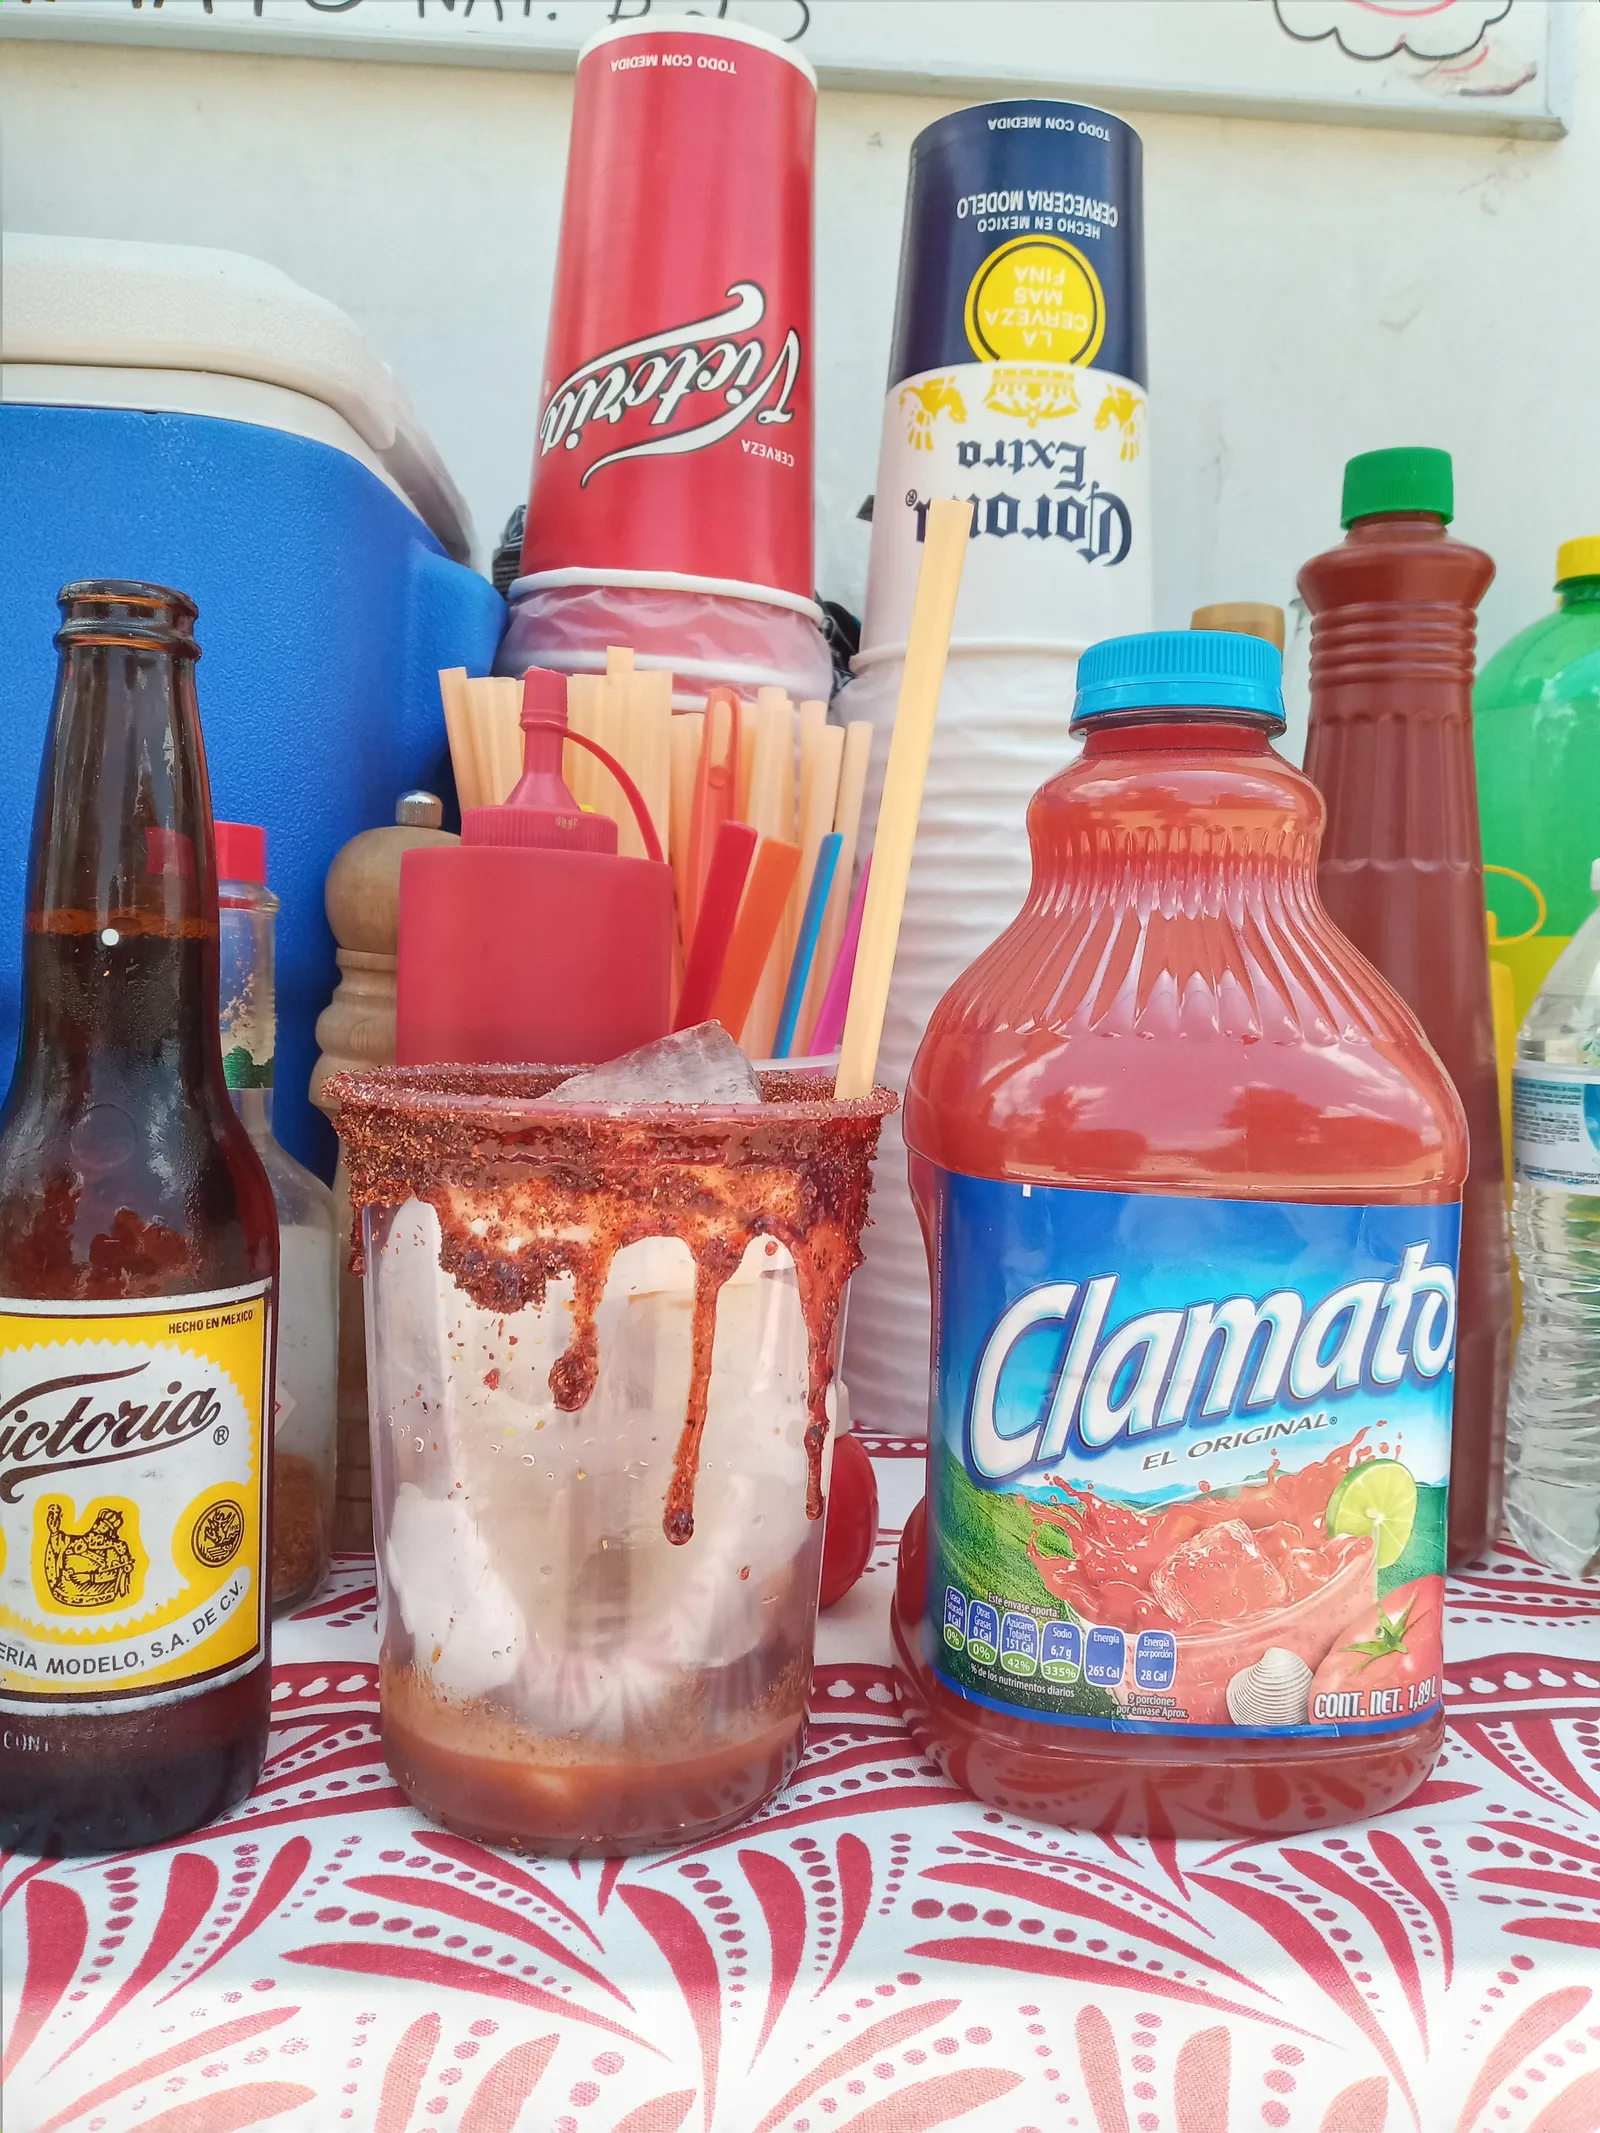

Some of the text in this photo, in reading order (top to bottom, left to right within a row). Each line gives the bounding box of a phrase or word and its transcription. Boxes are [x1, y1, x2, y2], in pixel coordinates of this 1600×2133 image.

[610, 54, 737, 75] TODO CON MEDIDA
[987, 116, 1111, 142] TODO CON MEDIDA
[956, 190, 1119, 228] CERVECERIA MODELO
[977, 215, 1101, 240] HECHO EN MEXICO
[1014, 265, 1066, 285] FINA
[1014, 287, 1063, 307] MAS
[985, 308, 1089, 333] CERVEZA
[1022, 330, 1052, 348] LA
[539, 279, 801, 489] Victoria
[741, 439, 795, 467] CERVEZA
[956, 439, 1087, 491] Extra
[168, 1309, 253, 1335] HECHO EN MEXICO
[967, 1241, 1456, 1480] Clamato
[1143, 1451, 1177, 1470] EL
[976, 1606, 990, 1619] Otras
[988, 1592, 1060, 1618] Este envase aporta:
[46, 1652, 145, 1676] MODELO,
[151, 1633, 190, 1658] S.A.
[192, 1608, 218, 1635] DE
[219, 1580, 243, 1611] C.V.
[952, 1614, 961, 1628] Cal
[975, 1615, 992, 1630] Grasas
[947, 1628, 960, 1645] 0%
[973, 1627, 992, 1642] 0 Cal
[1009, 1628, 1031, 1641] Totales
[1052, 1627, 1072, 1639] Sodio
[1093, 1631, 1120, 1645] Energía
[973, 1644, 990, 1660] 0%
[1006, 1638, 1034, 1653] 151 Cal
[1050, 1645, 1072, 1660] 6,7 g
[1139, 1649, 1173, 1659] por porción
[1007, 1658, 1030, 1671] 42%
[1045, 1665, 1076, 1678] 335%
[1088, 1665, 1119, 1678] 265 Cal
[978, 1667, 987, 1678] de
[988, 1670, 997, 1682] los
[999, 1676, 1046, 1693] nutrimentos
[1047, 1685, 1075, 1698] diarios
[1141, 1670, 1167, 1682] 28 Cal
[1129, 1694, 1176, 1706] 9 porciones
[1314, 1692, 1366, 1718] CONT.
[1408, 1679, 1431, 1711] 1,89
[1116, 1706, 1189, 1720] por envase Aprox.
